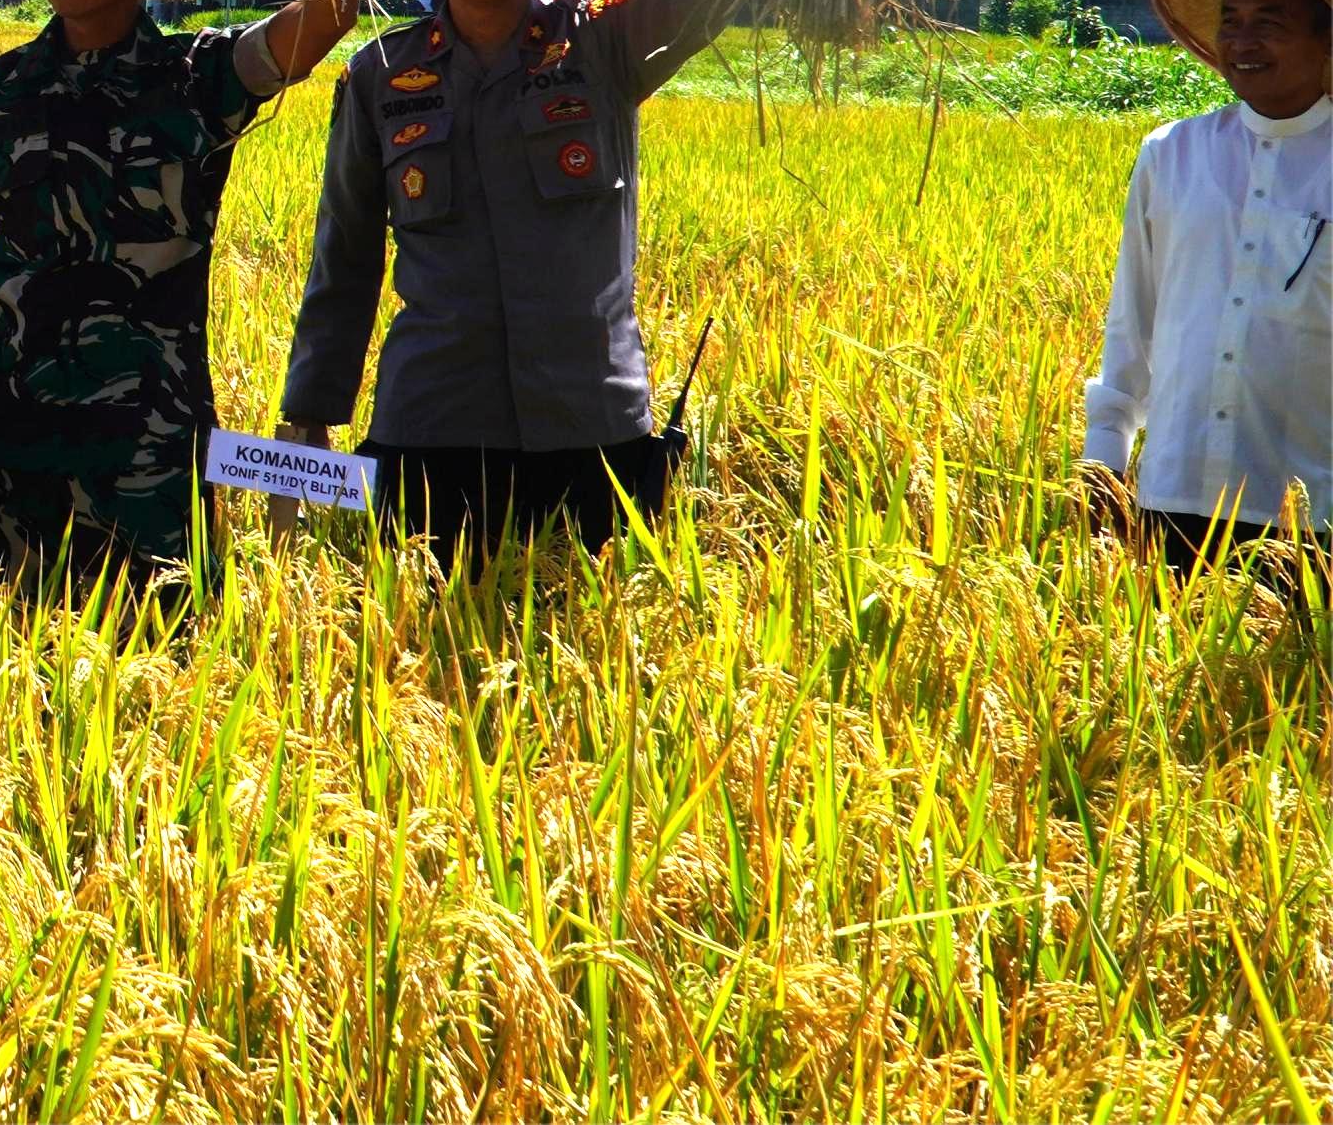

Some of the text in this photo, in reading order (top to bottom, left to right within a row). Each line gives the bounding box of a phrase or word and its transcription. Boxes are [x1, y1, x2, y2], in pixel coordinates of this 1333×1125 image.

[235, 445, 347, 480] KOMANDAN
[220, 463, 359, 501] YONIF 511/DY BLITAR
